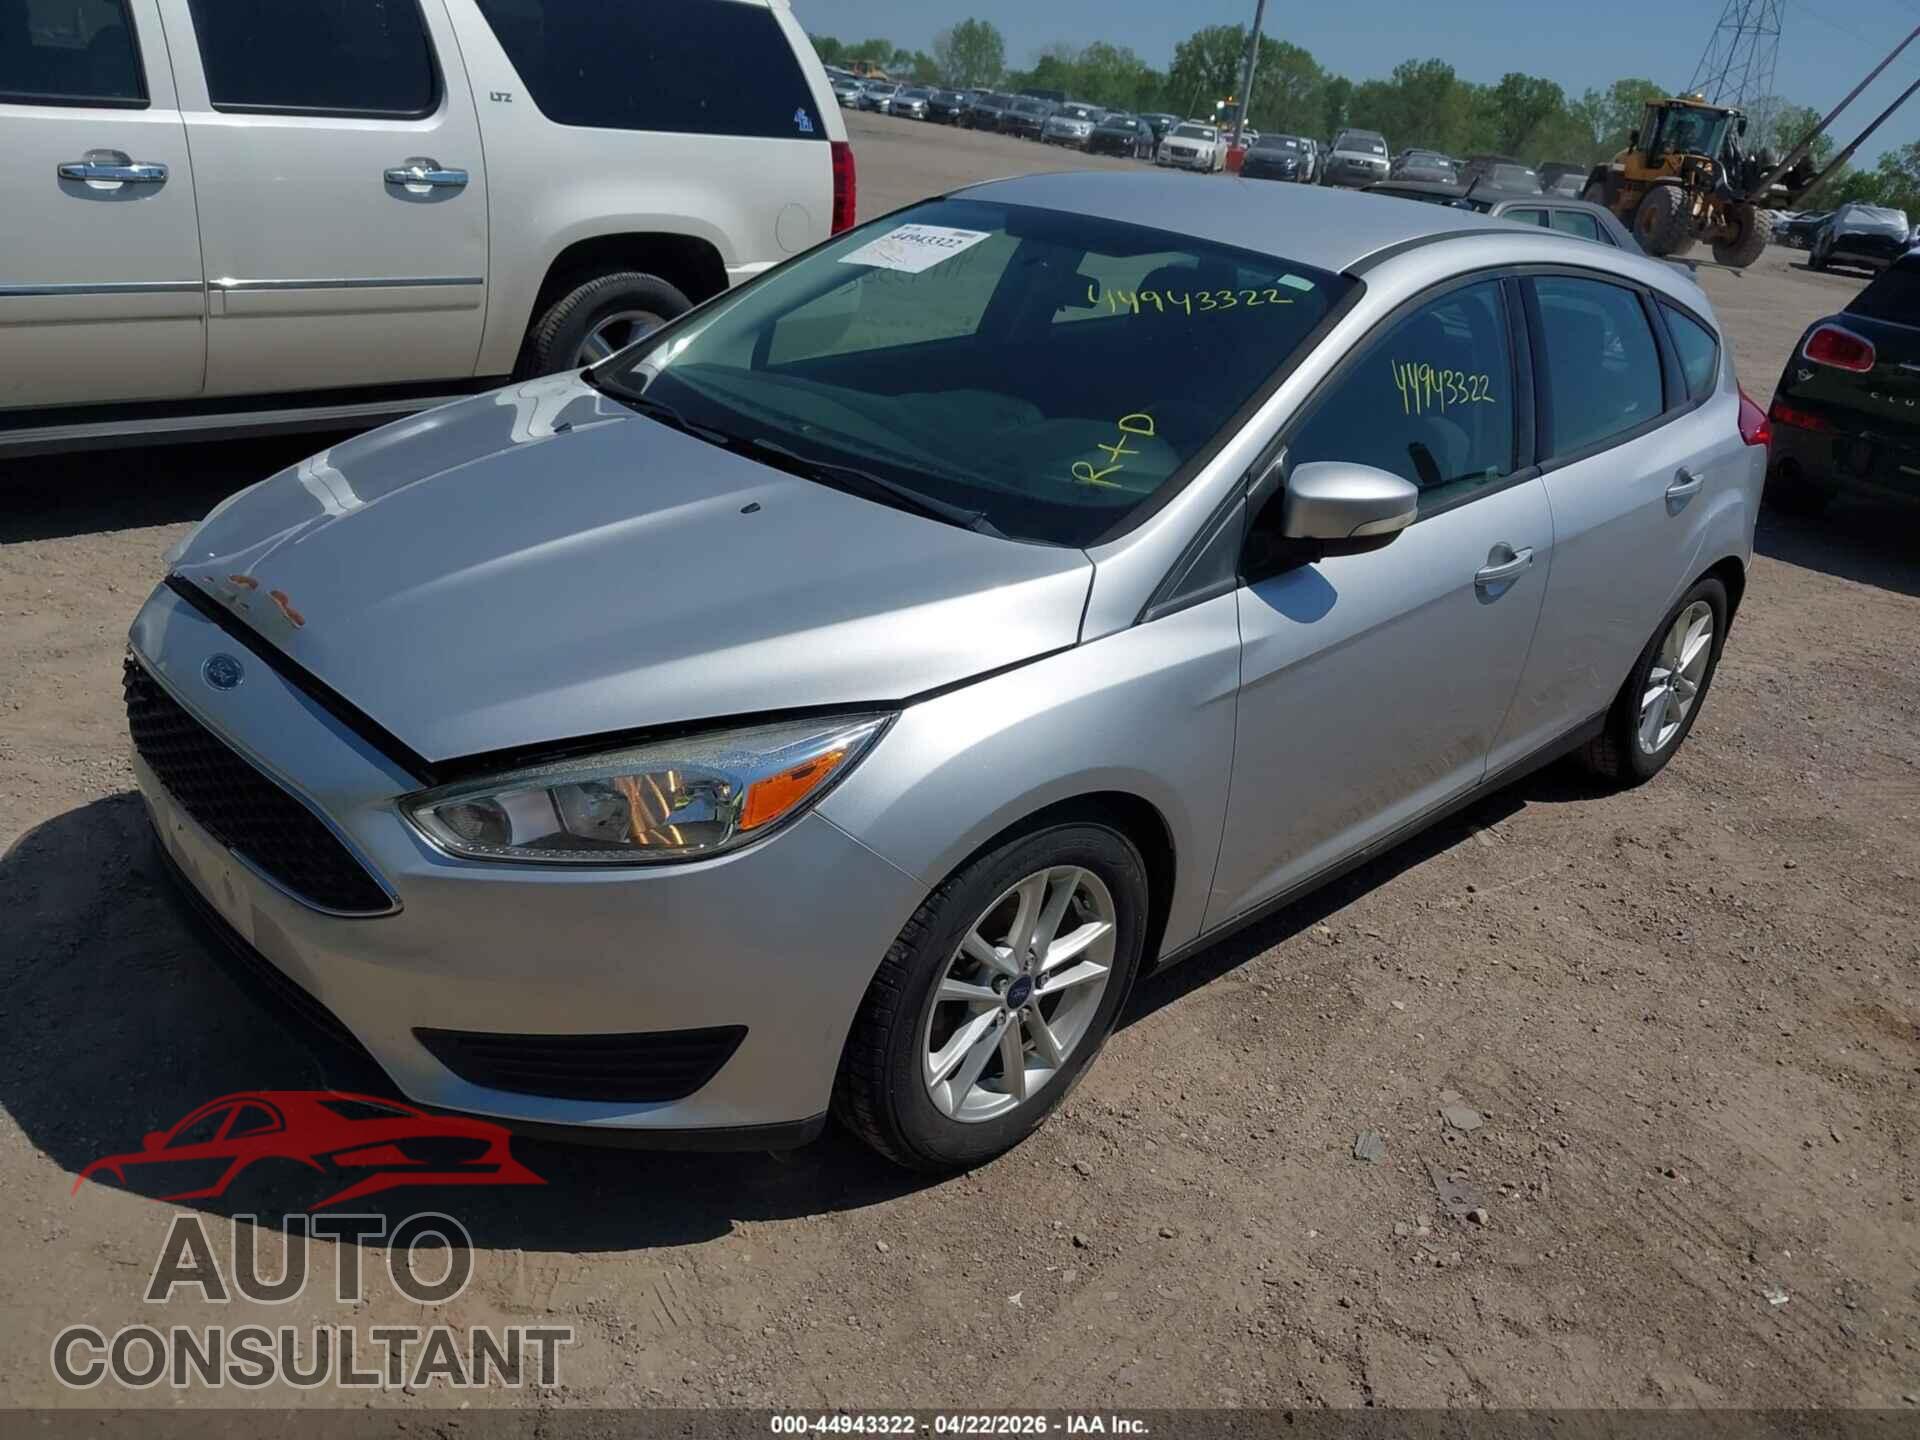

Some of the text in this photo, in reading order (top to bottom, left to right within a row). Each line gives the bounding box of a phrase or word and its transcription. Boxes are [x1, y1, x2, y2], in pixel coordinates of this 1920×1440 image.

[490, 91, 513, 103] LTZ
[1088, 284, 1294, 315] 44943322
[1391, 357, 1496, 415] 44943322
